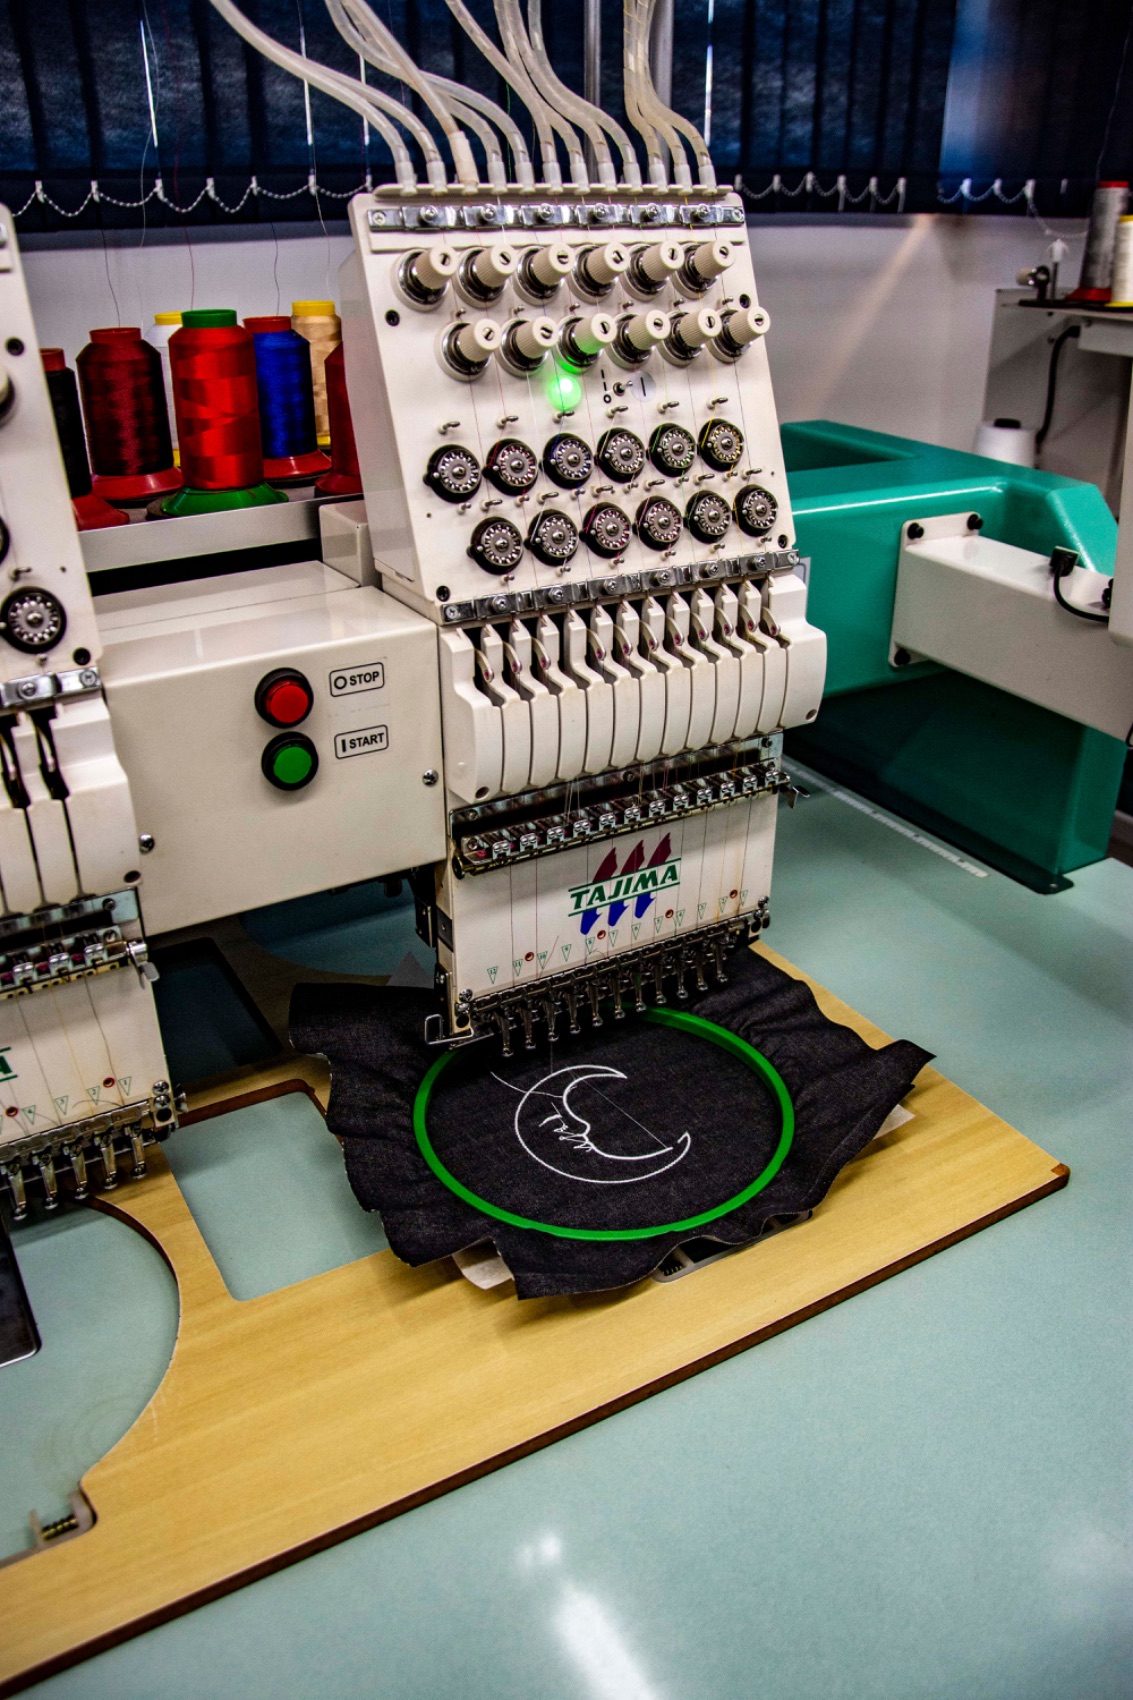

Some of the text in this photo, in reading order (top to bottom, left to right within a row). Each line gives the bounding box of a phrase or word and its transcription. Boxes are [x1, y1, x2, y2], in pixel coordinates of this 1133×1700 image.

[349, 671, 380, 686] STOP
[349, 732, 385, 749] START
[570, 864, 679, 910] TAJIMA
